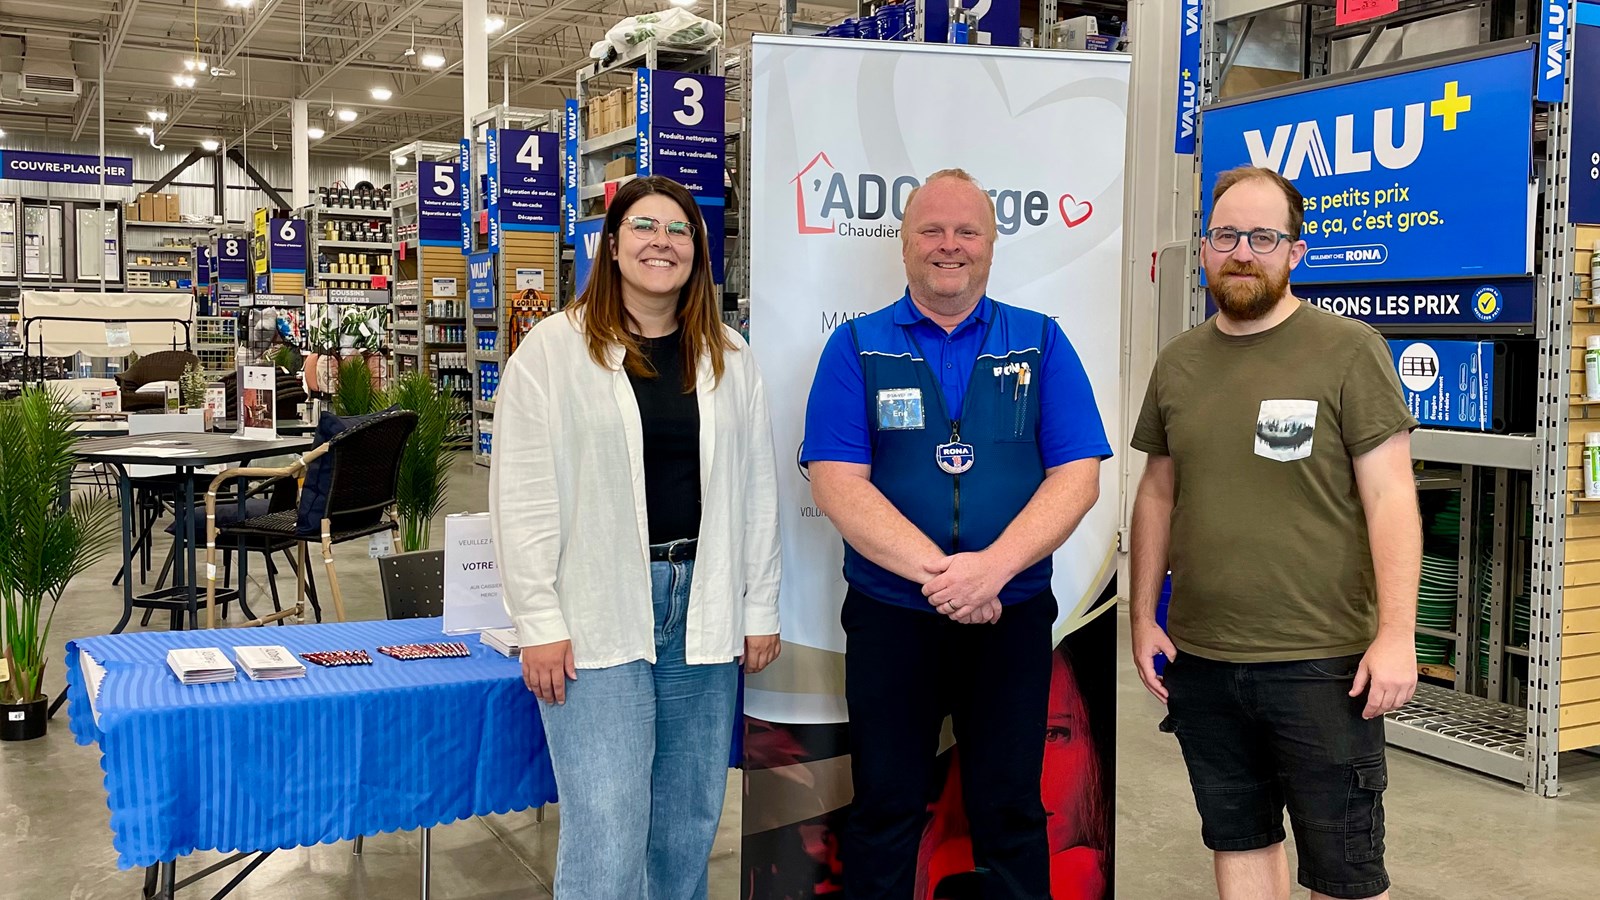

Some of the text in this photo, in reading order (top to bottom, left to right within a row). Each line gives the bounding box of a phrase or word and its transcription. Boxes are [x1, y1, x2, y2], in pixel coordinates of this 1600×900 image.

[672, 78, 704, 126] 3
[660, 132, 684, 140] Produits
[516, 135, 543, 171] 4
[10, 160, 125, 176] COUVRE-PLANCHER
[433, 165, 455, 196] 5
[1321, 188, 1370, 213] petits
[1375, 182, 1409, 208] prix
[280, 221, 296, 240] 6
[838, 222, 901, 238] Chaudièr
[1322, 218, 1347, 238] ça,
[1352, 210, 1393, 230] c'est
[1398, 210, 1444, 232] gros.
[226, 240, 238, 256] 8
[1346, 249, 1381, 261] RONA
[1376, 296, 1409, 315] LES
[1414, 294, 1460, 314] PRIX
[462, 561, 493, 570] VOTRE
